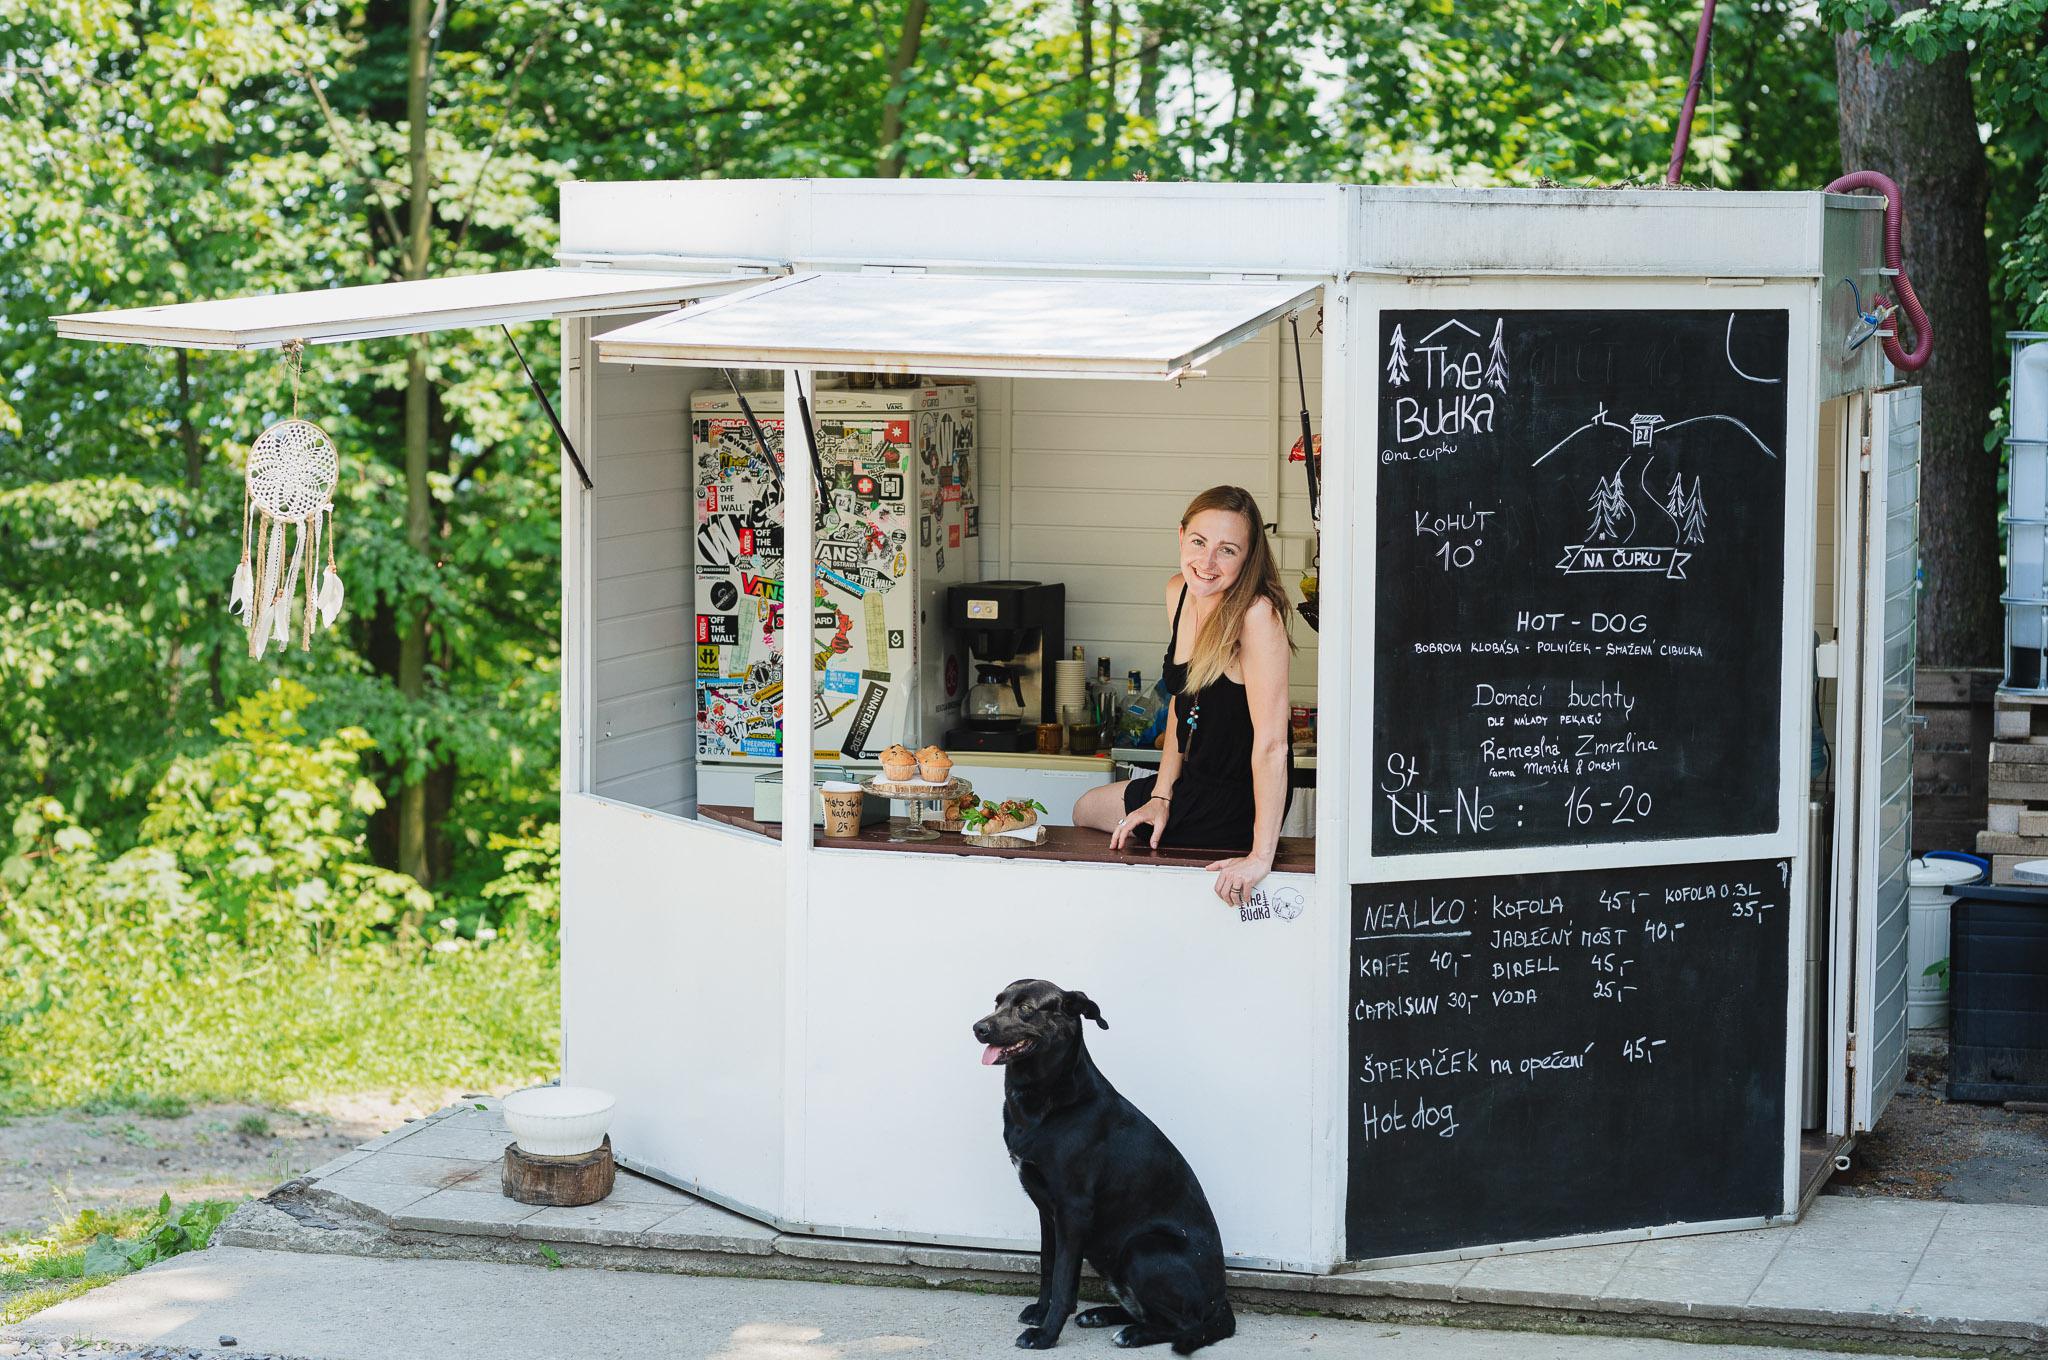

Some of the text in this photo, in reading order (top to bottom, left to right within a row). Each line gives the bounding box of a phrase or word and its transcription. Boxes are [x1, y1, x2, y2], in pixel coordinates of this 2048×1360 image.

[1414, 346, 1482, 391] The
[886, 402, 903, 410] VANS
[1381, 441, 1458, 465] @na_cupku
[755, 538, 772, 546] THE
[1434, 538, 1483, 571] 10°
[1584, 548, 1661, 568] NA ČUPKU
[859, 567, 878, 578] VANS
[860, 575, 874, 588] THE
[710, 625, 726, 633] THE
[1516, 611, 1565, 632] HOT
[1591, 612, 1647, 633] DOG
[1414, 642, 1462, 654] BOBROVA
[1470, 639, 1520, 655] KLOBÁSA
[1605, 639, 1656, 656] SMAŽENÁ
[1660, 644, 1703, 657] CIBULKA
[1471, 679, 1635, 720] Domácí buchty
[1487, 716, 1505, 727] DLE
[1514, 713, 1549, 726] NÁLADY
[1574, 731, 1659, 757] Zmrzlina
[1381, 752, 1420, 793] St
[1488, 767, 1517, 778] farma
[1564, 784, 1653, 827] 16-20
[1493, 894, 1564, 919] KOFOLA
[1665, 884, 1716, 904] KOFOLA
[1490, 920, 1573, 949] JABLEČNÝ
[1360, 952, 1410, 978] KAFE
[1492, 955, 1560, 980] BIRELL
[1492, 988, 1537, 1007] VODA
[1359, 1047, 1479, 1083] ŠPEKÁČEK
[1490, 1056, 1513, 1075] na
[1520, 1042, 1594, 1081] opečení
[1363, 1096, 1460, 1142] Hot dog
